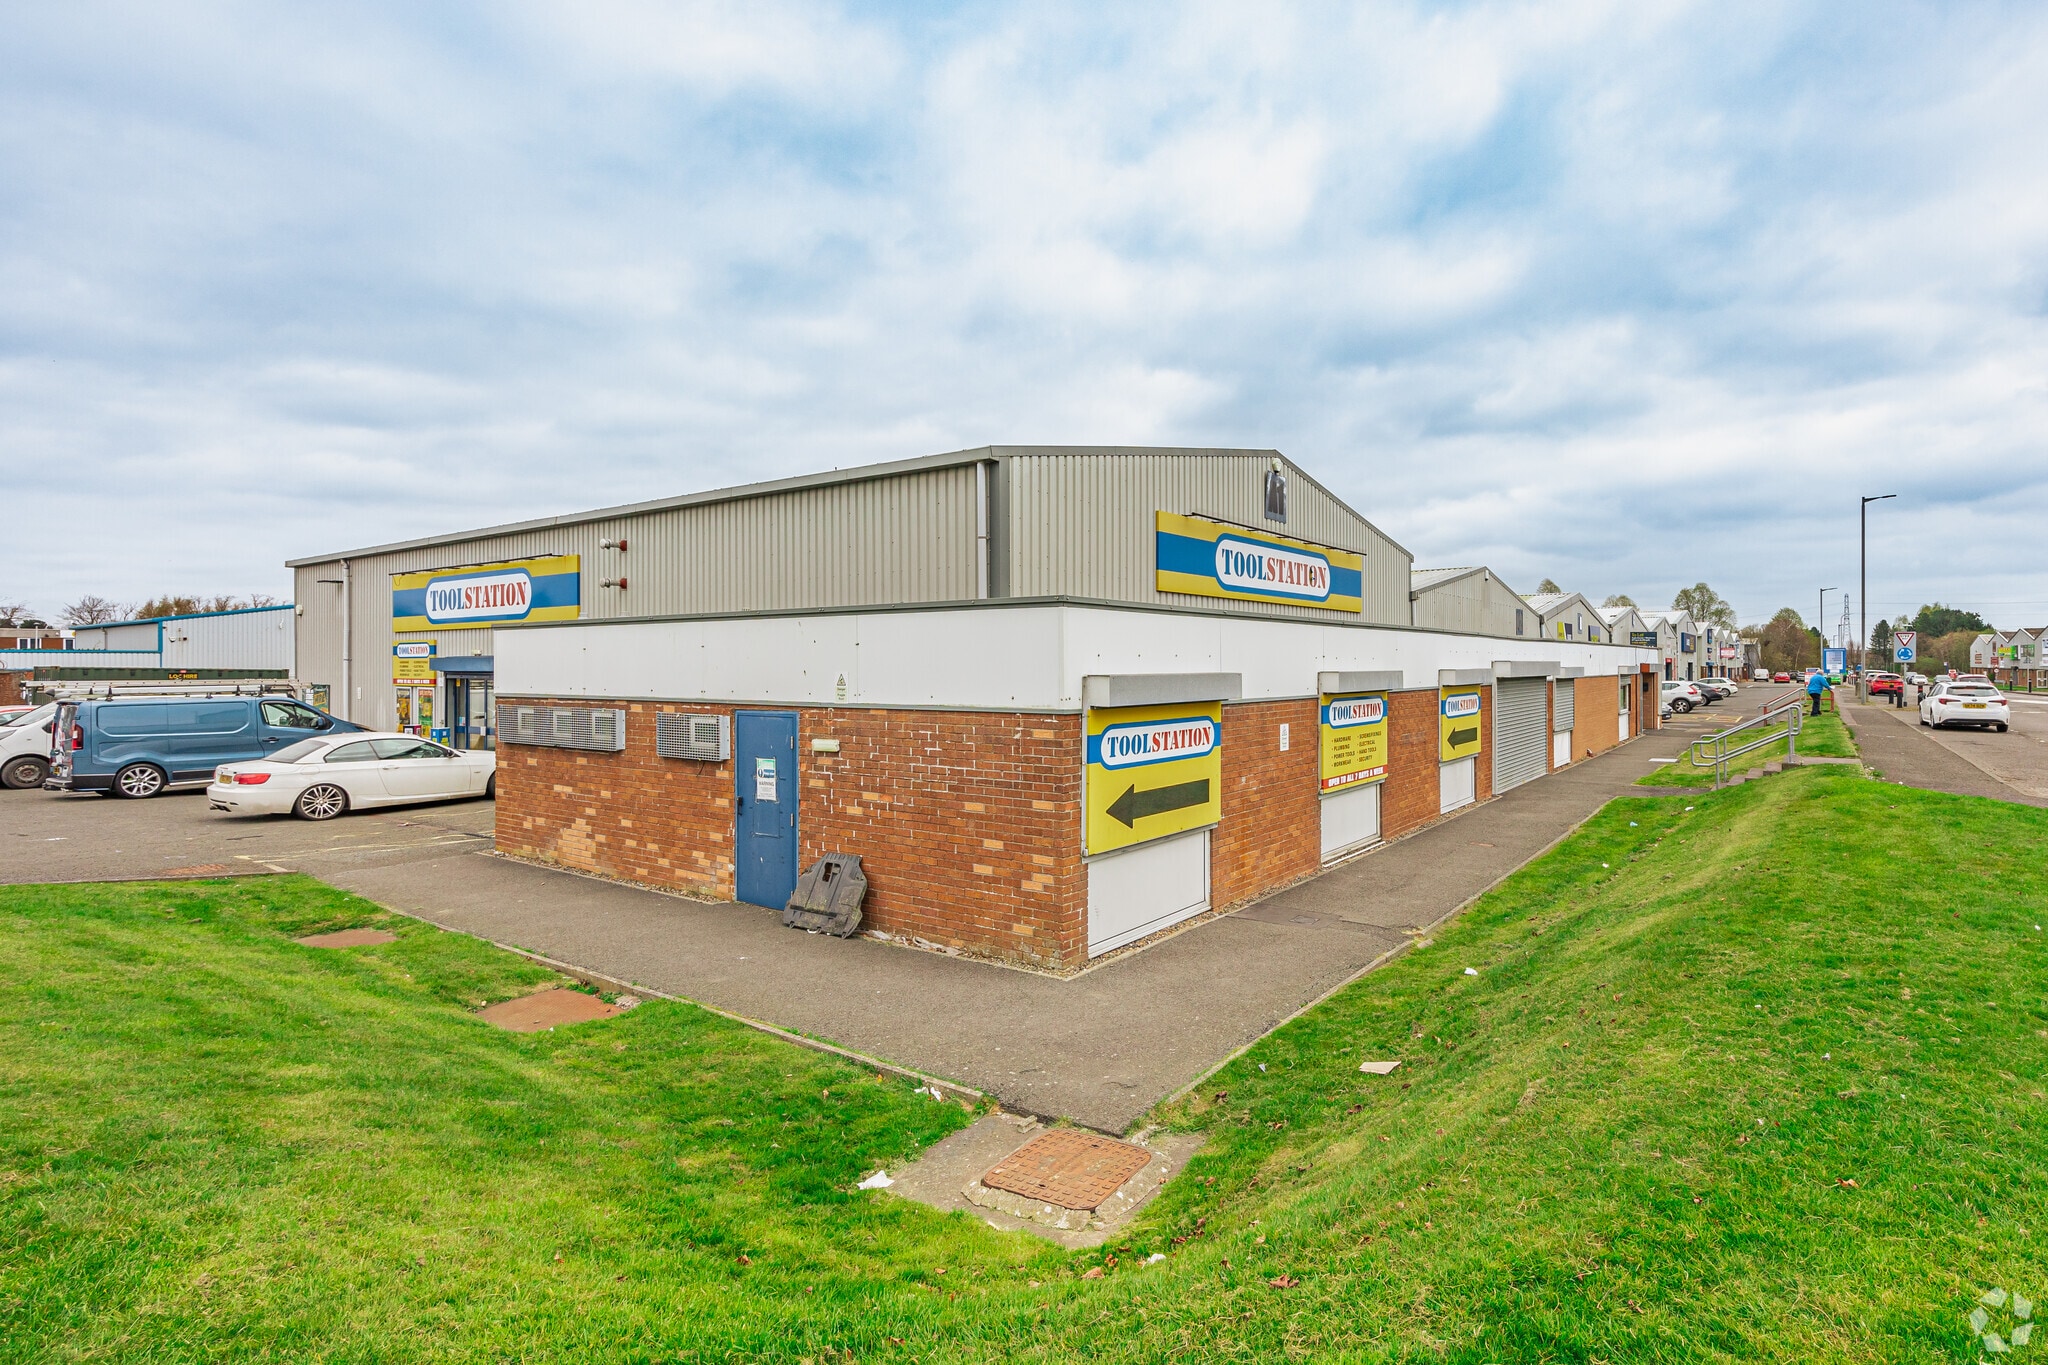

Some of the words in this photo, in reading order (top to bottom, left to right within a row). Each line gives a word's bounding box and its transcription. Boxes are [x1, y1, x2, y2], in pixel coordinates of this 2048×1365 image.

[1222, 548, 1327, 589] TOOLSTATION
[430, 581, 527, 612] TOOLSTATION
[1332, 702, 1382, 721] TOOLSTATION
[1447, 698, 1478, 713] TOOLSTATION
[1107, 726, 1211, 758] TOOLSTATION
[1334, 735, 1351, 743] HARDWARE
[1334, 752, 1345, 760] POWER
[1334, 759, 1351, 767] WORKWEAR
[1328, 776, 1340, 787] OPEN
[1340, 775, 1347, 784] TO
[1346, 773, 1354, 782] ALL
